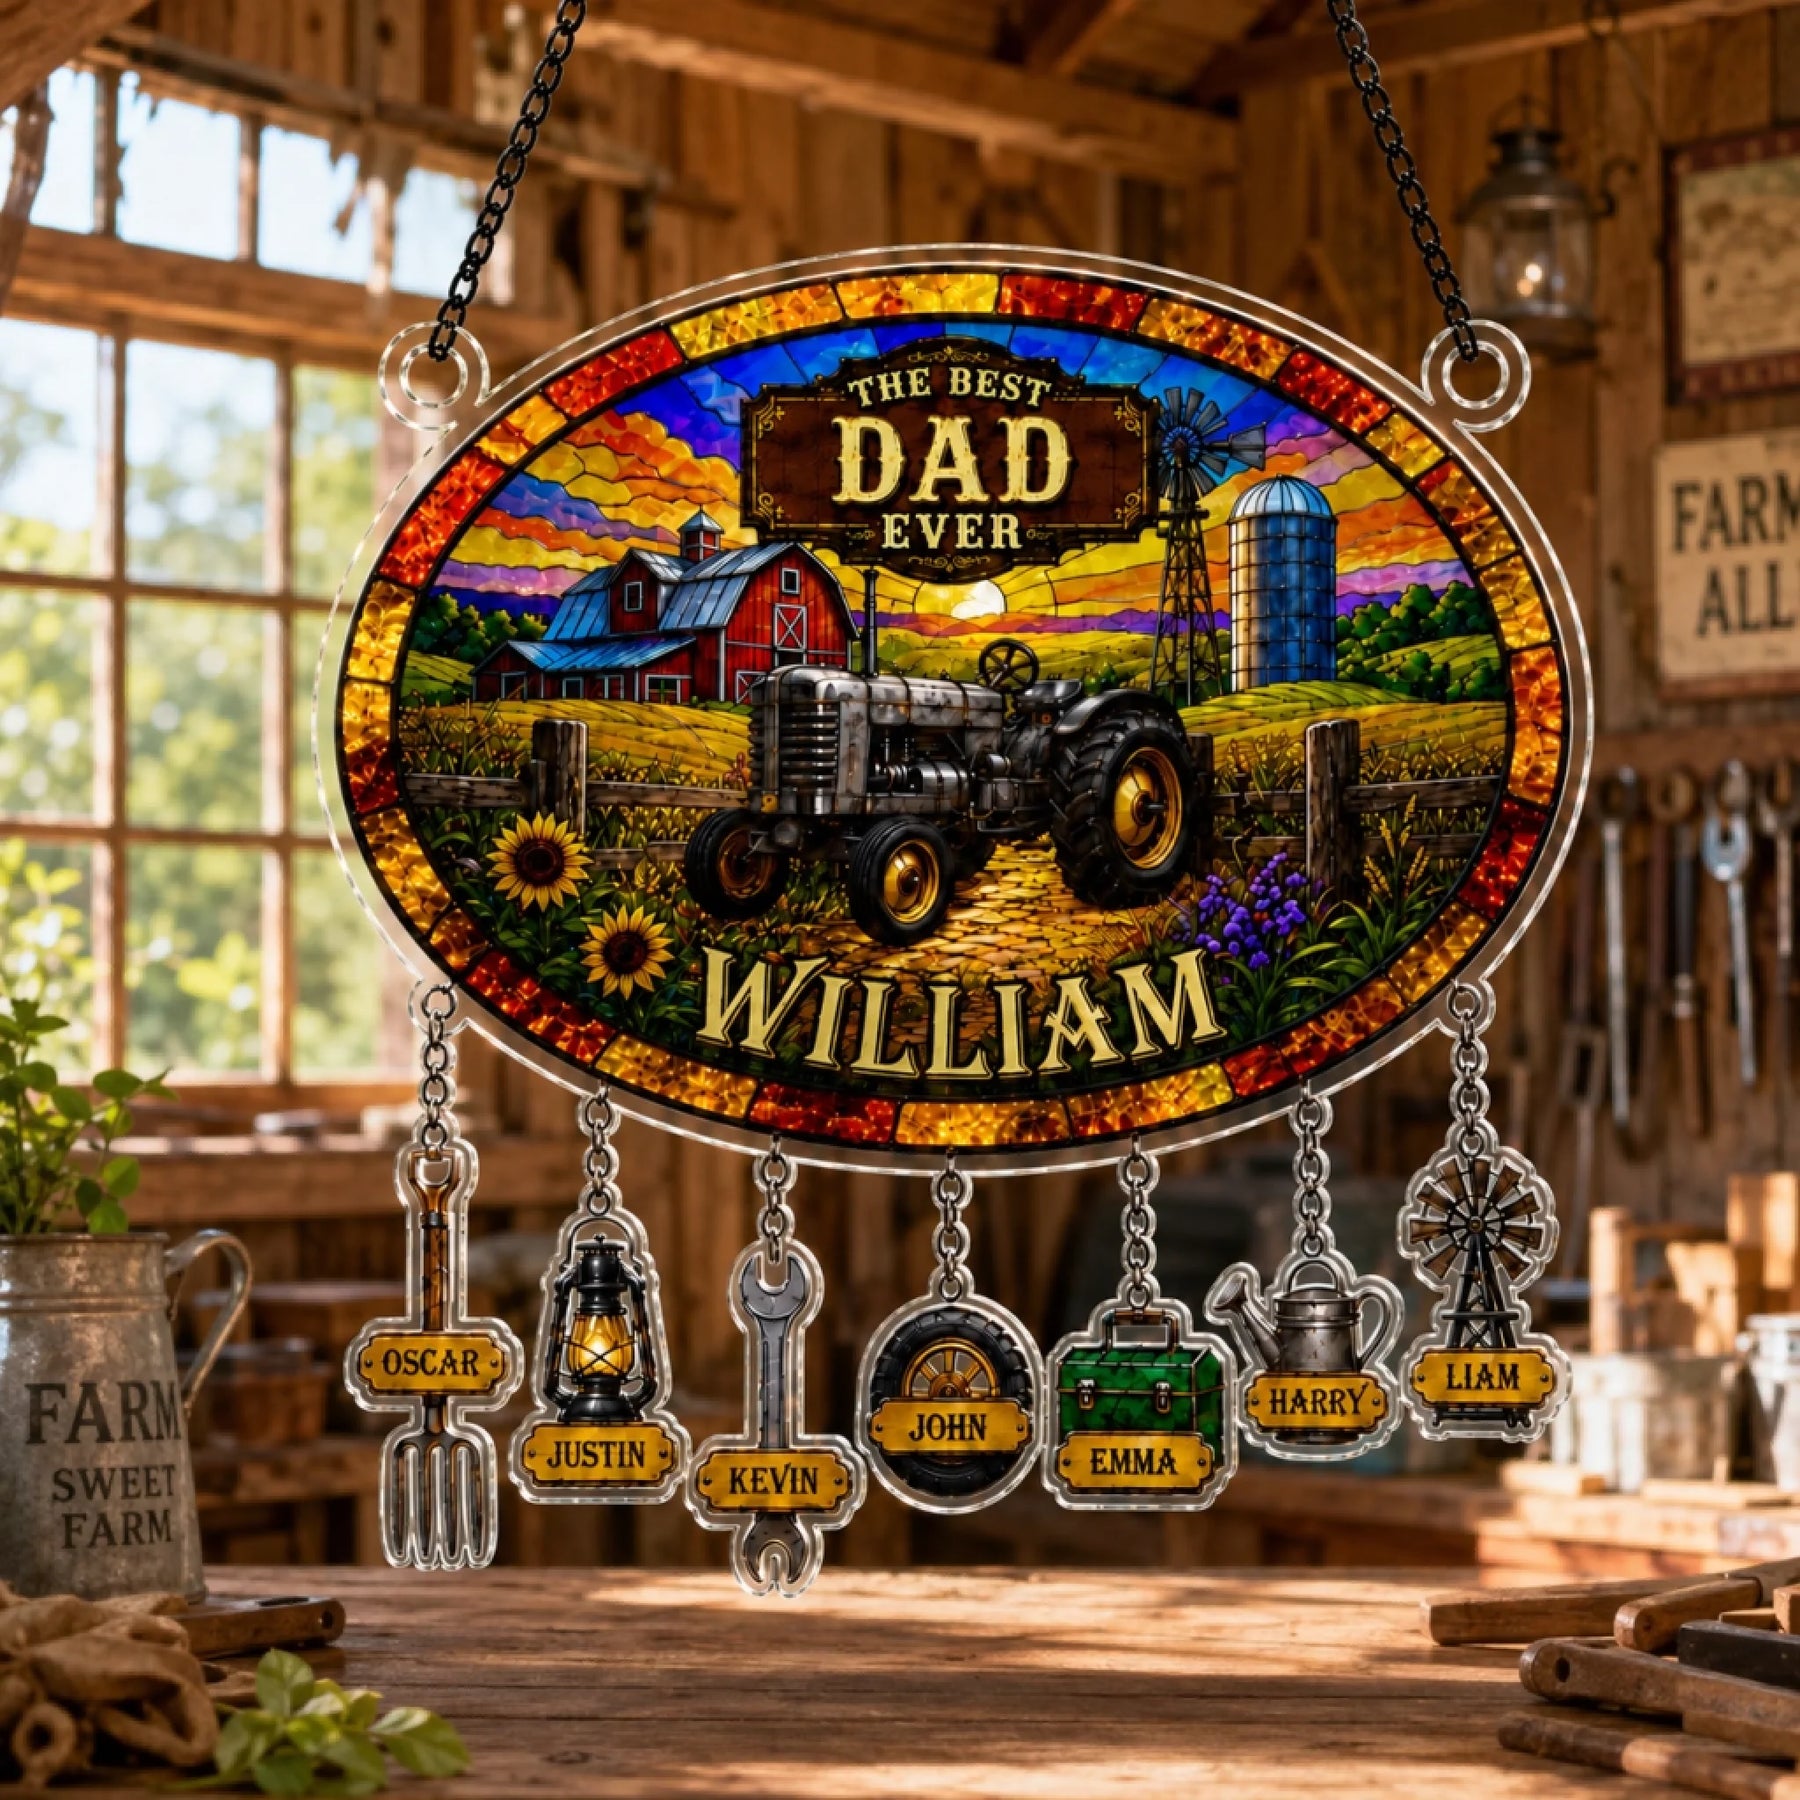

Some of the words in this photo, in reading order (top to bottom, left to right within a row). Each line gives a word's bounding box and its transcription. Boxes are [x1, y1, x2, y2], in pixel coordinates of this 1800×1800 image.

[847, 367, 930, 407] THE
[948, 366, 1053, 407] BEST
[831, 415, 1073, 504] DAD
[881, 512, 1023, 550] EVER
[696, 946, 1228, 1081] WILLIAM
[382, 1349, 480, 1377] OSCAR
[1445, 1361, 1520, 1391] LIAM
[24, 1380, 182, 1444] FARM
[1268, 1380, 1370, 1416] HARRY
[908, 1413, 988, 1442] JOHN
[546, 1440, 647, 1469] JUSTIN
[1090, 1447, 1178, 1476] EMMA
[52, 1464, 176, 1502] SWEET
[728, 1462, 820, 1496] KEVIN
[61, 1508, 173, 1550] FARM
